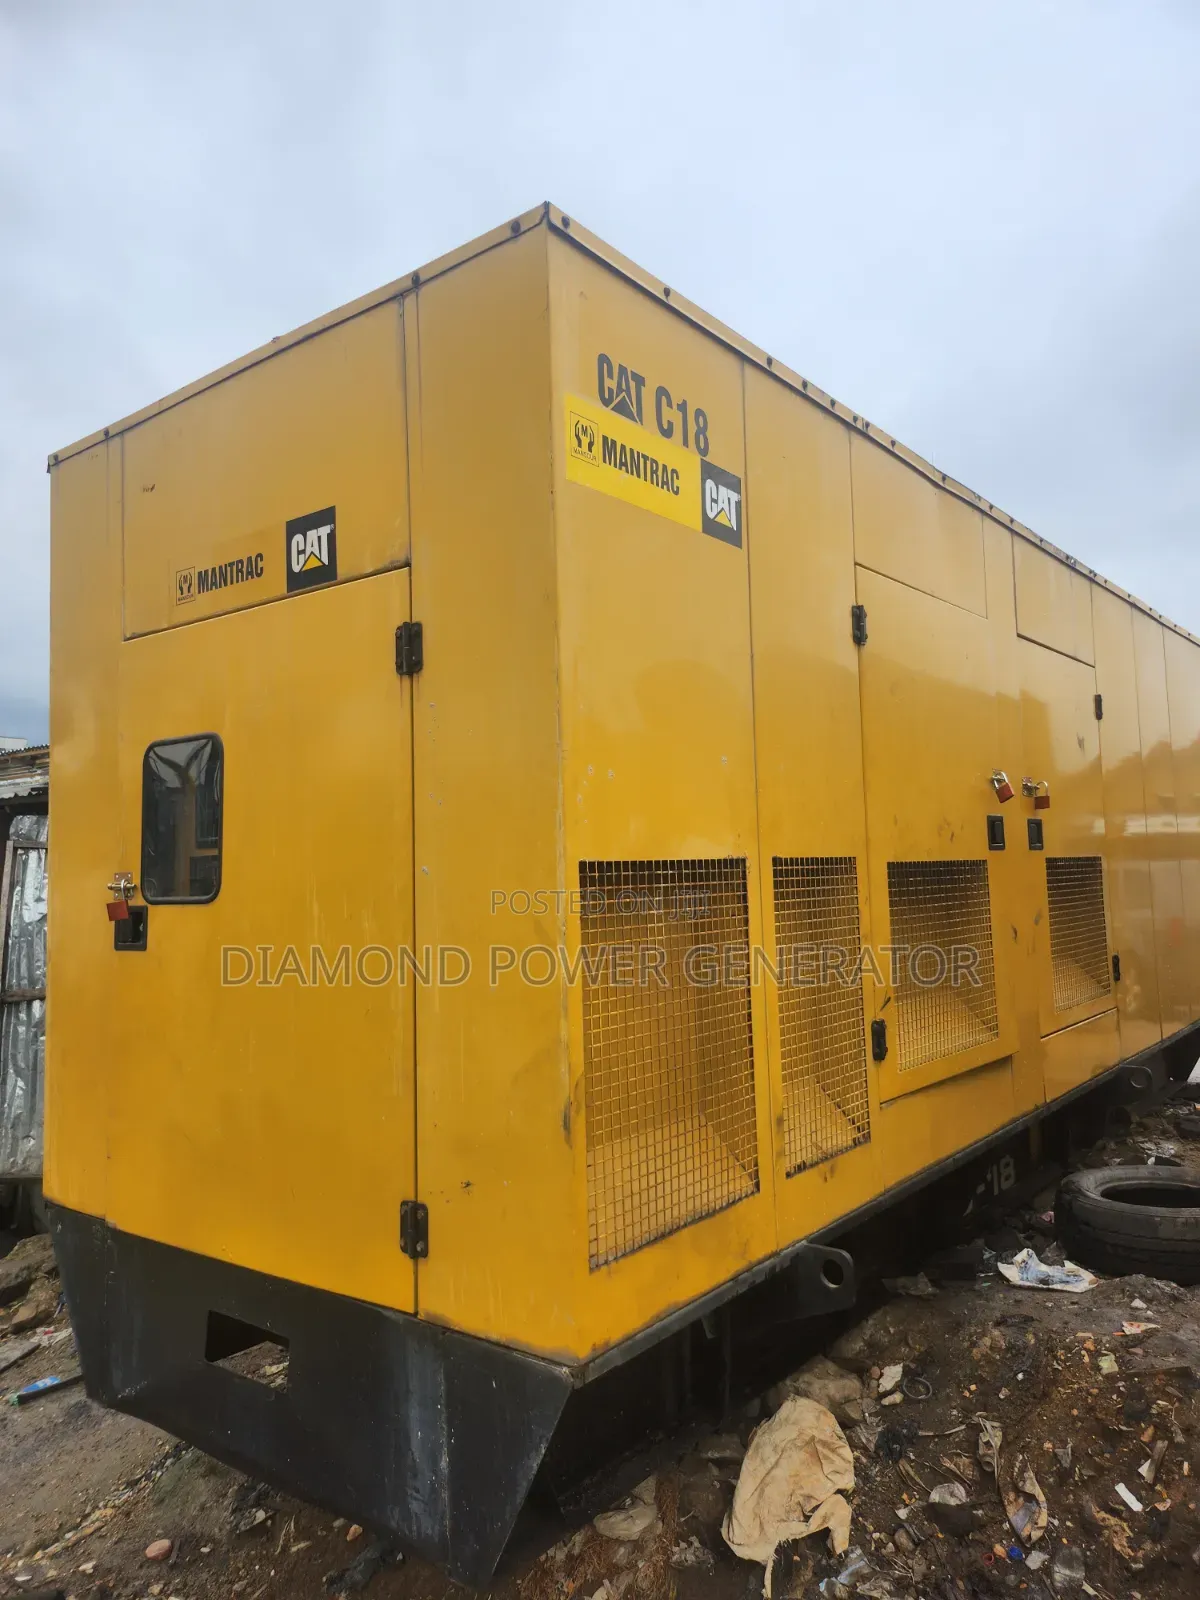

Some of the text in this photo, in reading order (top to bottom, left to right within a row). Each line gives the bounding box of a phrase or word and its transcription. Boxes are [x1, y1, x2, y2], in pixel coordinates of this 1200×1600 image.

[597, 353, 710, 458] CAT C18
[602, 434, 680, 496] MANTRAC
[705, 479, 739, 531] CAT
[197, 553, 264, 594] MANTRAC
[291, 524, 331, 573] CAT
